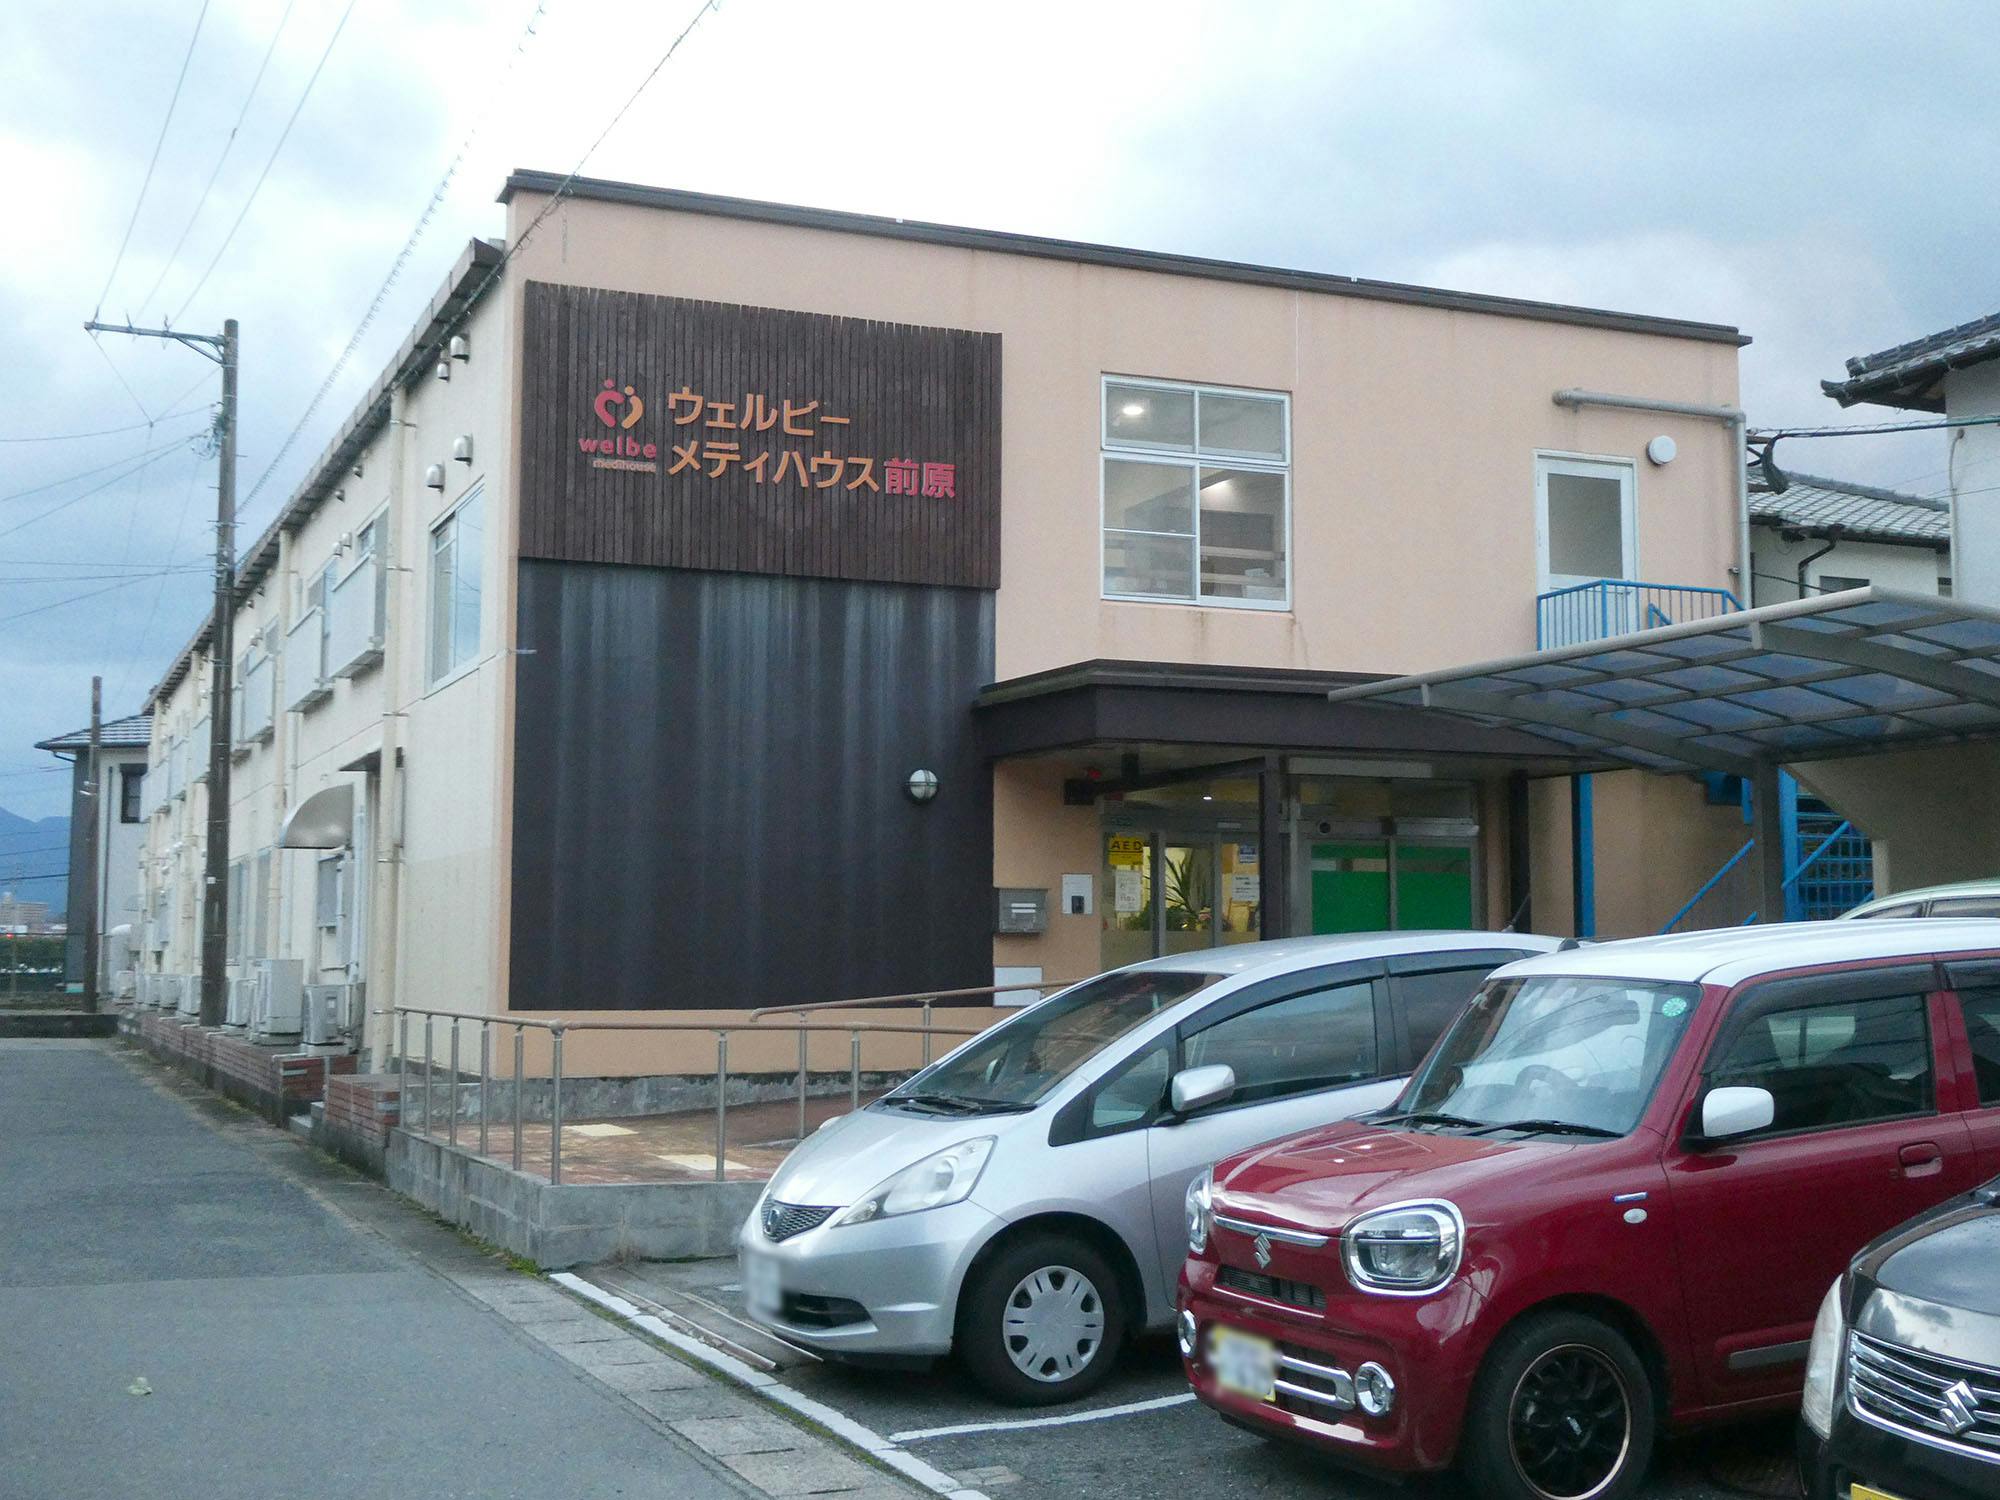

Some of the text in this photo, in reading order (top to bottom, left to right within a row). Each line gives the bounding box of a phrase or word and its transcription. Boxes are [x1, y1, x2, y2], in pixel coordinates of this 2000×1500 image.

[668, 386, 850, 436] ウェルビー
[579, 435, 657, 458] welbe
[1111, 840, 1143, 850] AED
